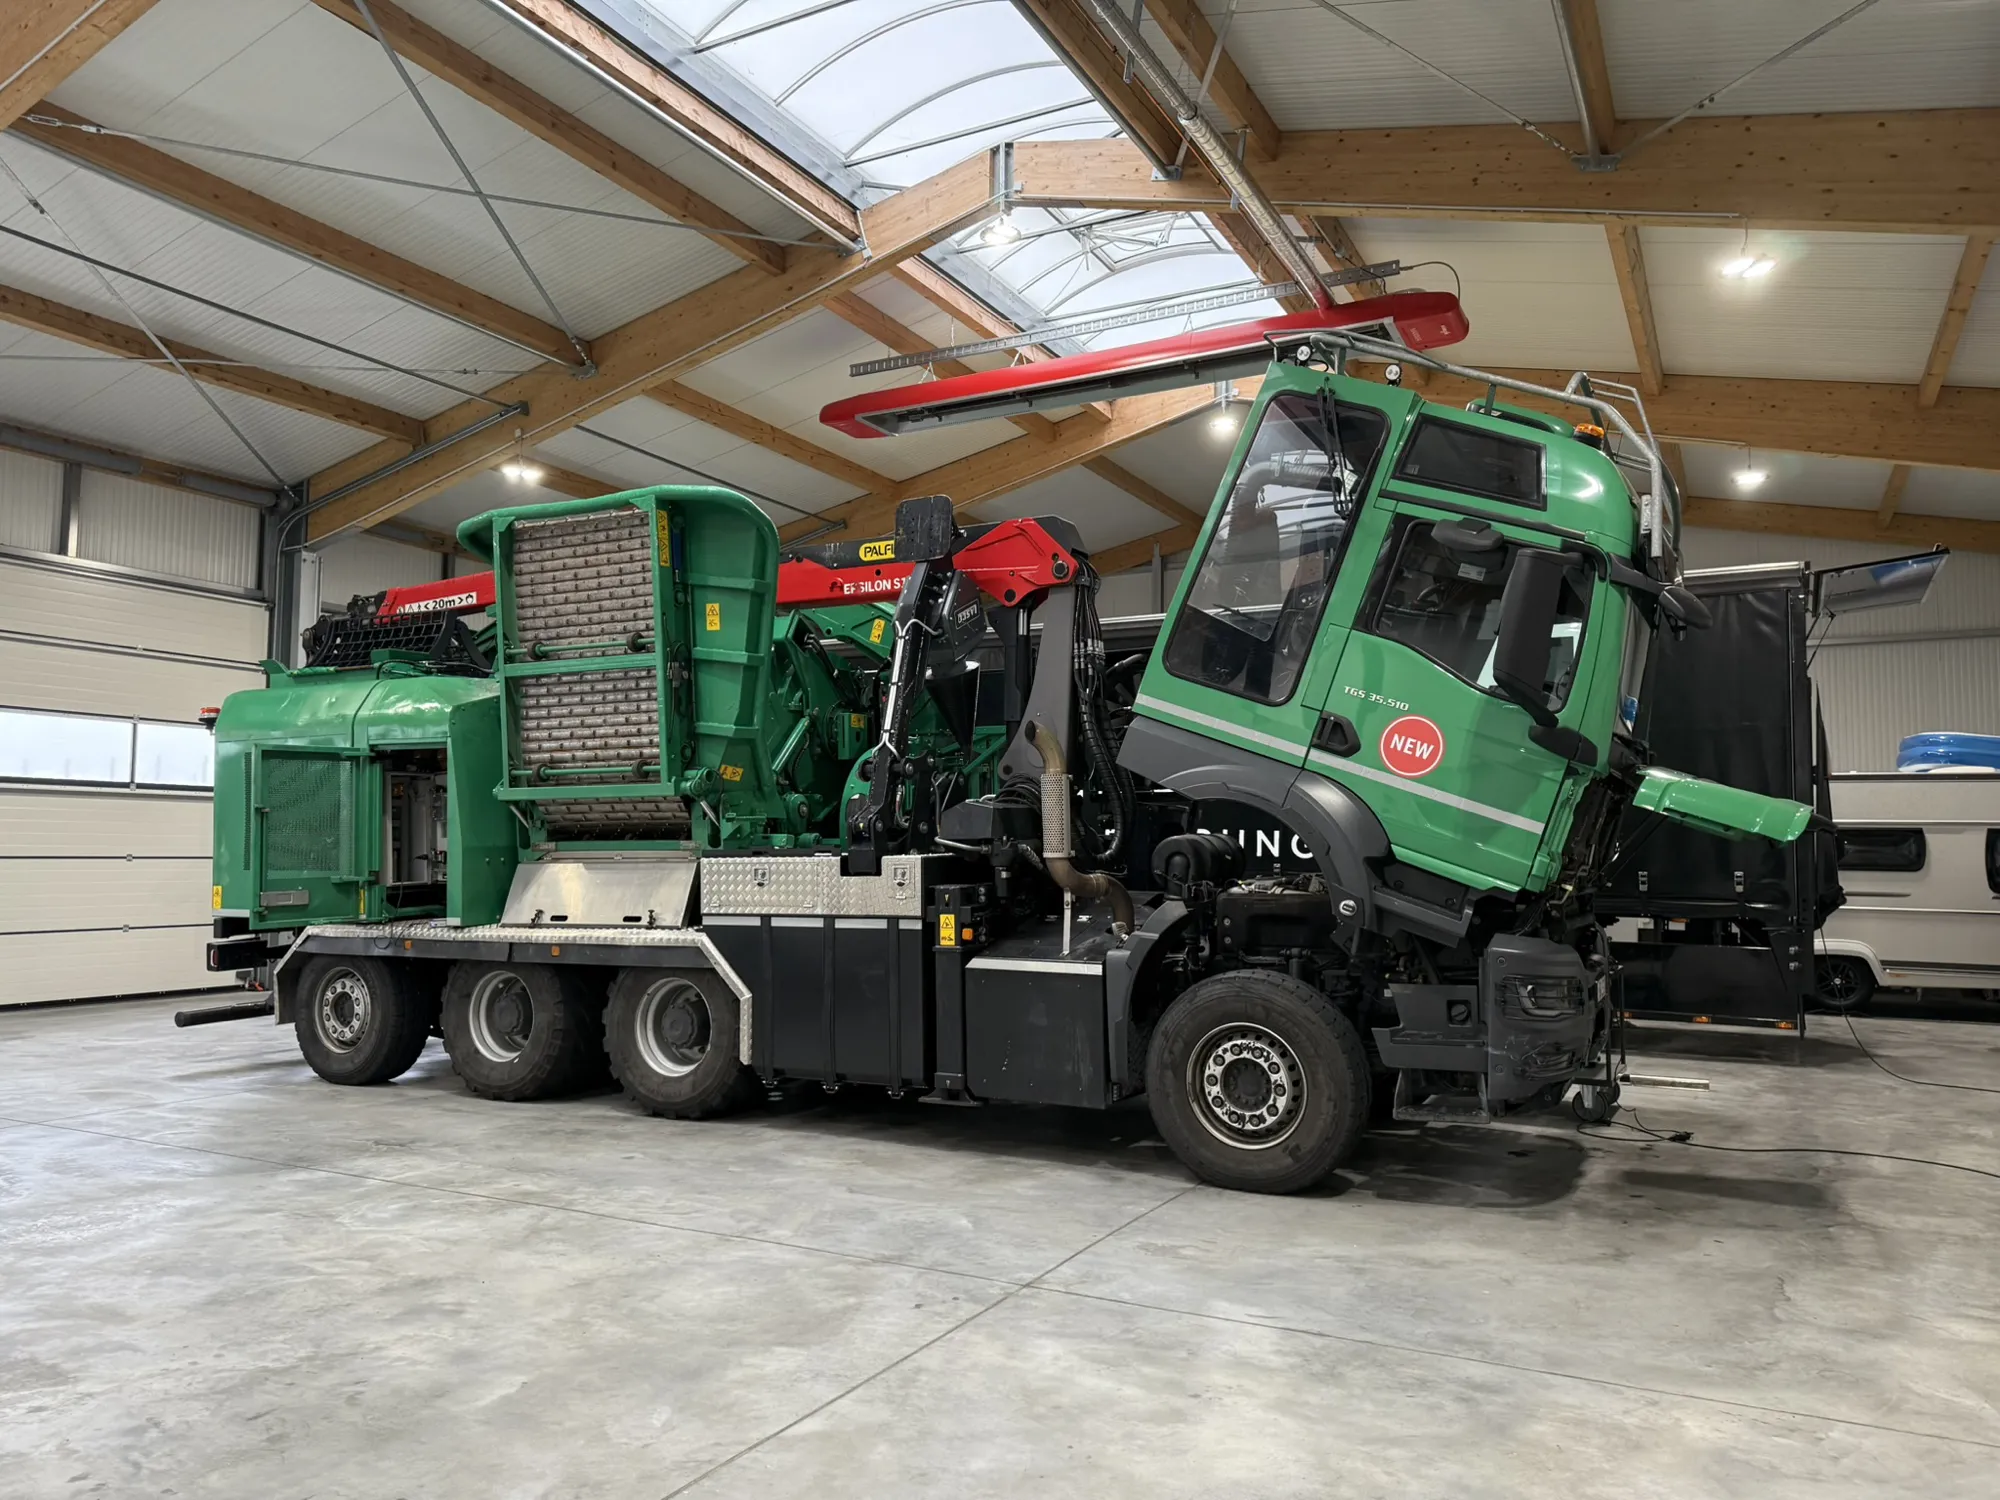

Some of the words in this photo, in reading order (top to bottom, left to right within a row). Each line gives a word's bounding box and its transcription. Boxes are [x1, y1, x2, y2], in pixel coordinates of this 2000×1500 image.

[1344, 685, 1366, 699] TGS
[1367, 692, 1409, 711] 35.510
[1390, 733, 1434, 760] NEW
